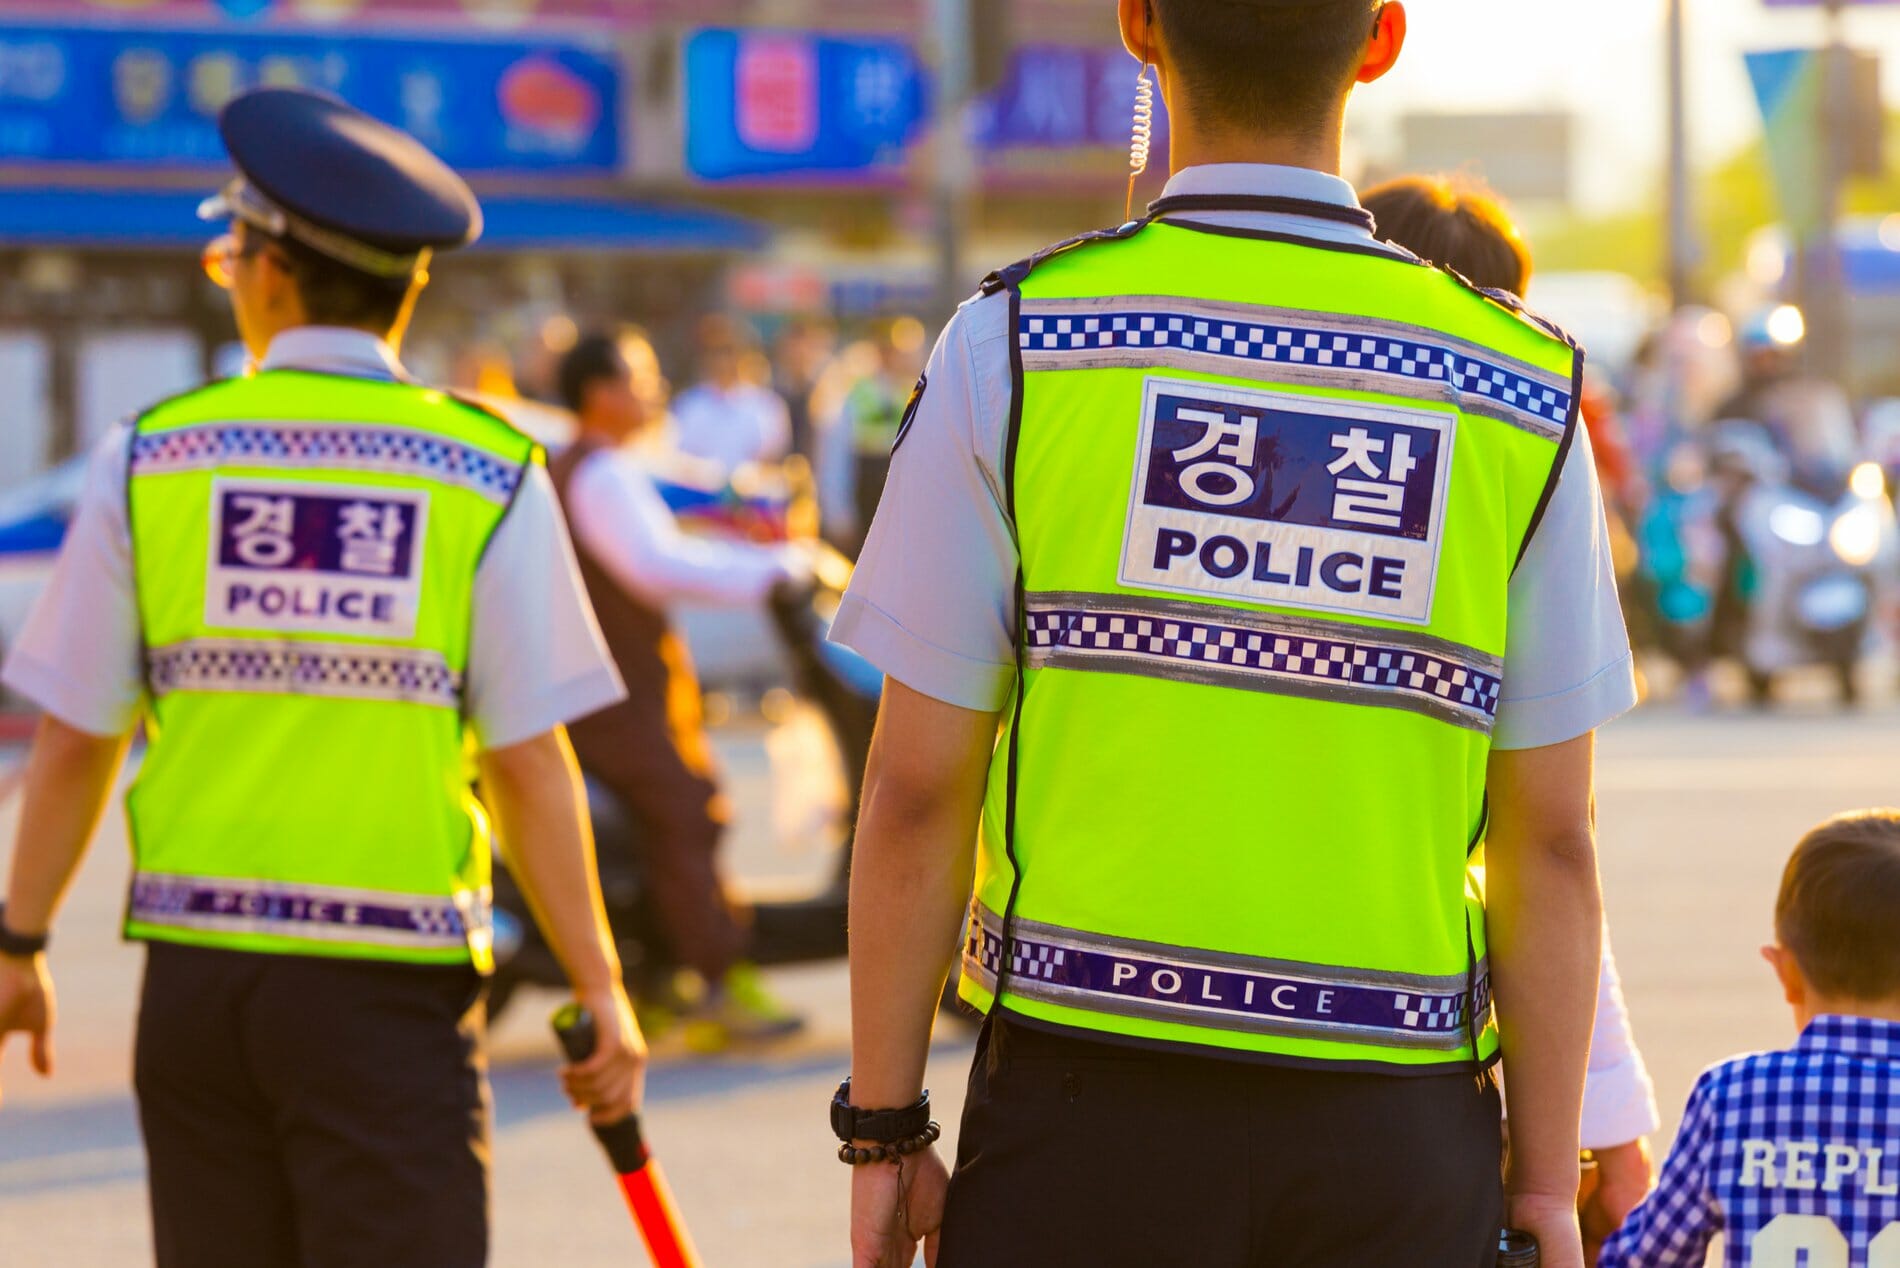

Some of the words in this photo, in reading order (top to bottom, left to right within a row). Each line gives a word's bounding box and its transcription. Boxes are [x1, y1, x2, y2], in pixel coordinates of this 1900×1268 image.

[1172, 407, 1416, 528] 경찰
[1153, 527, 1406, 600] POLICE
[226, 583, 394, 622] POLICE
[1112, 962, 1335, 1014] POLICE
[1738, 1139, 1898, 1196] REPL
